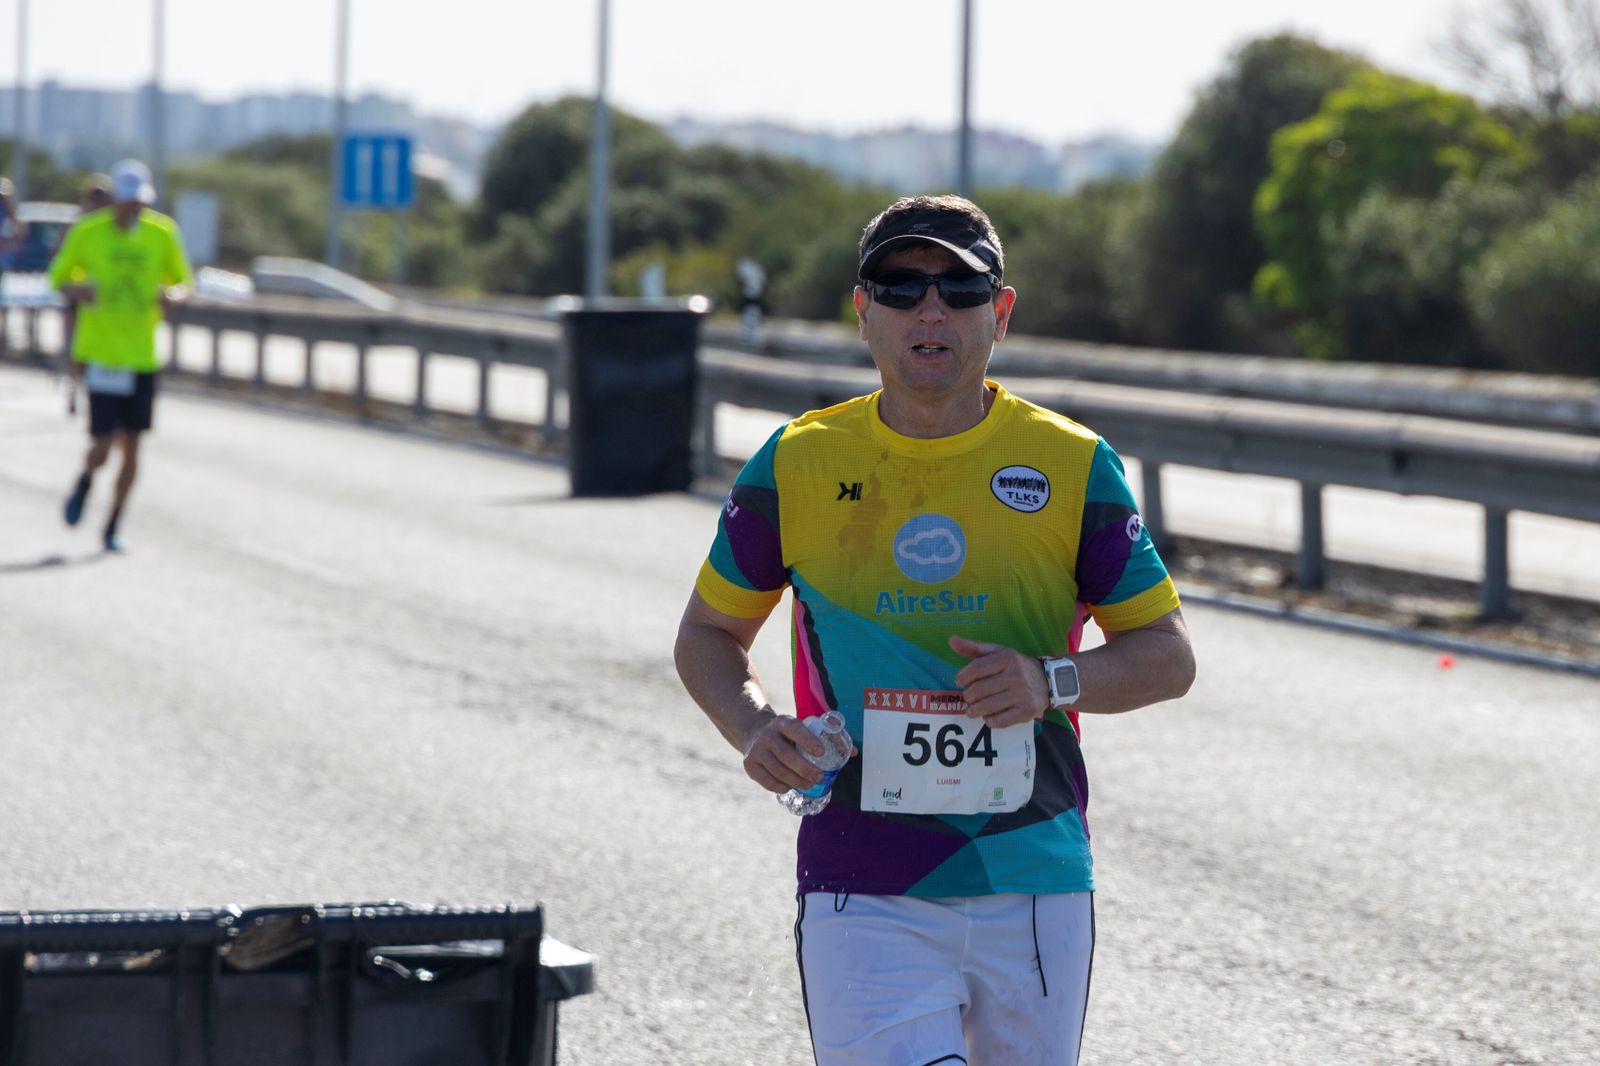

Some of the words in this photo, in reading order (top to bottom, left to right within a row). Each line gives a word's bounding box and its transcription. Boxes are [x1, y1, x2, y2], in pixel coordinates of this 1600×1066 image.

[1006, 491, 1040, 504] TLKS
[875, 589, 989, 614] AireSur
[902, 722, 998, 767] 564
